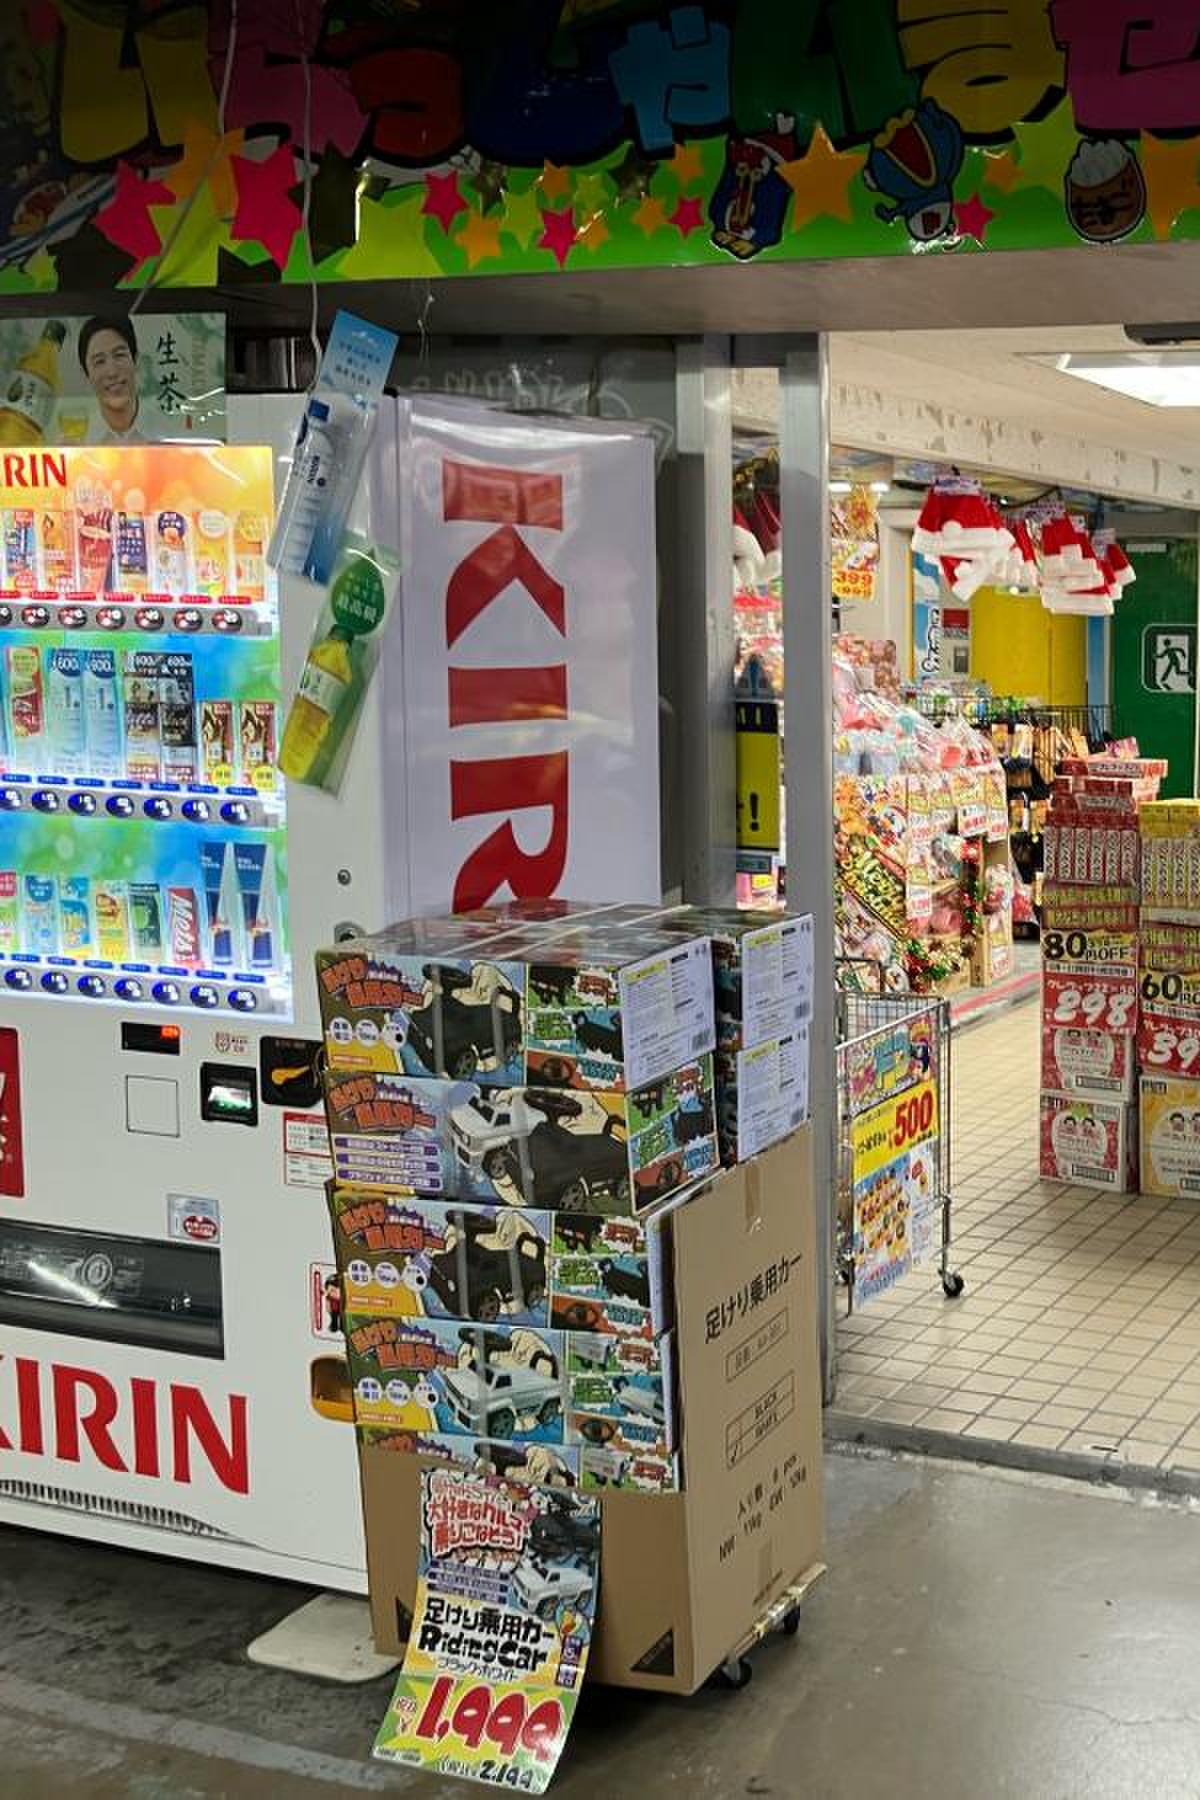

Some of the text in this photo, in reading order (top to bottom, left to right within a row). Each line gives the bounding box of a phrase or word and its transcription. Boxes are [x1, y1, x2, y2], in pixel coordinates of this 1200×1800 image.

[156, 332, 190, 414] 生茶
[0, 452, 68, 488] RIN
[893, 1088, 935, 1147] 500
[704, 1253, 803, 1345] 足けり乗用カー
[0, 1354, 250, 1495] IRIN
[424, 1596, 555, 1643] 足けり乗用カー
